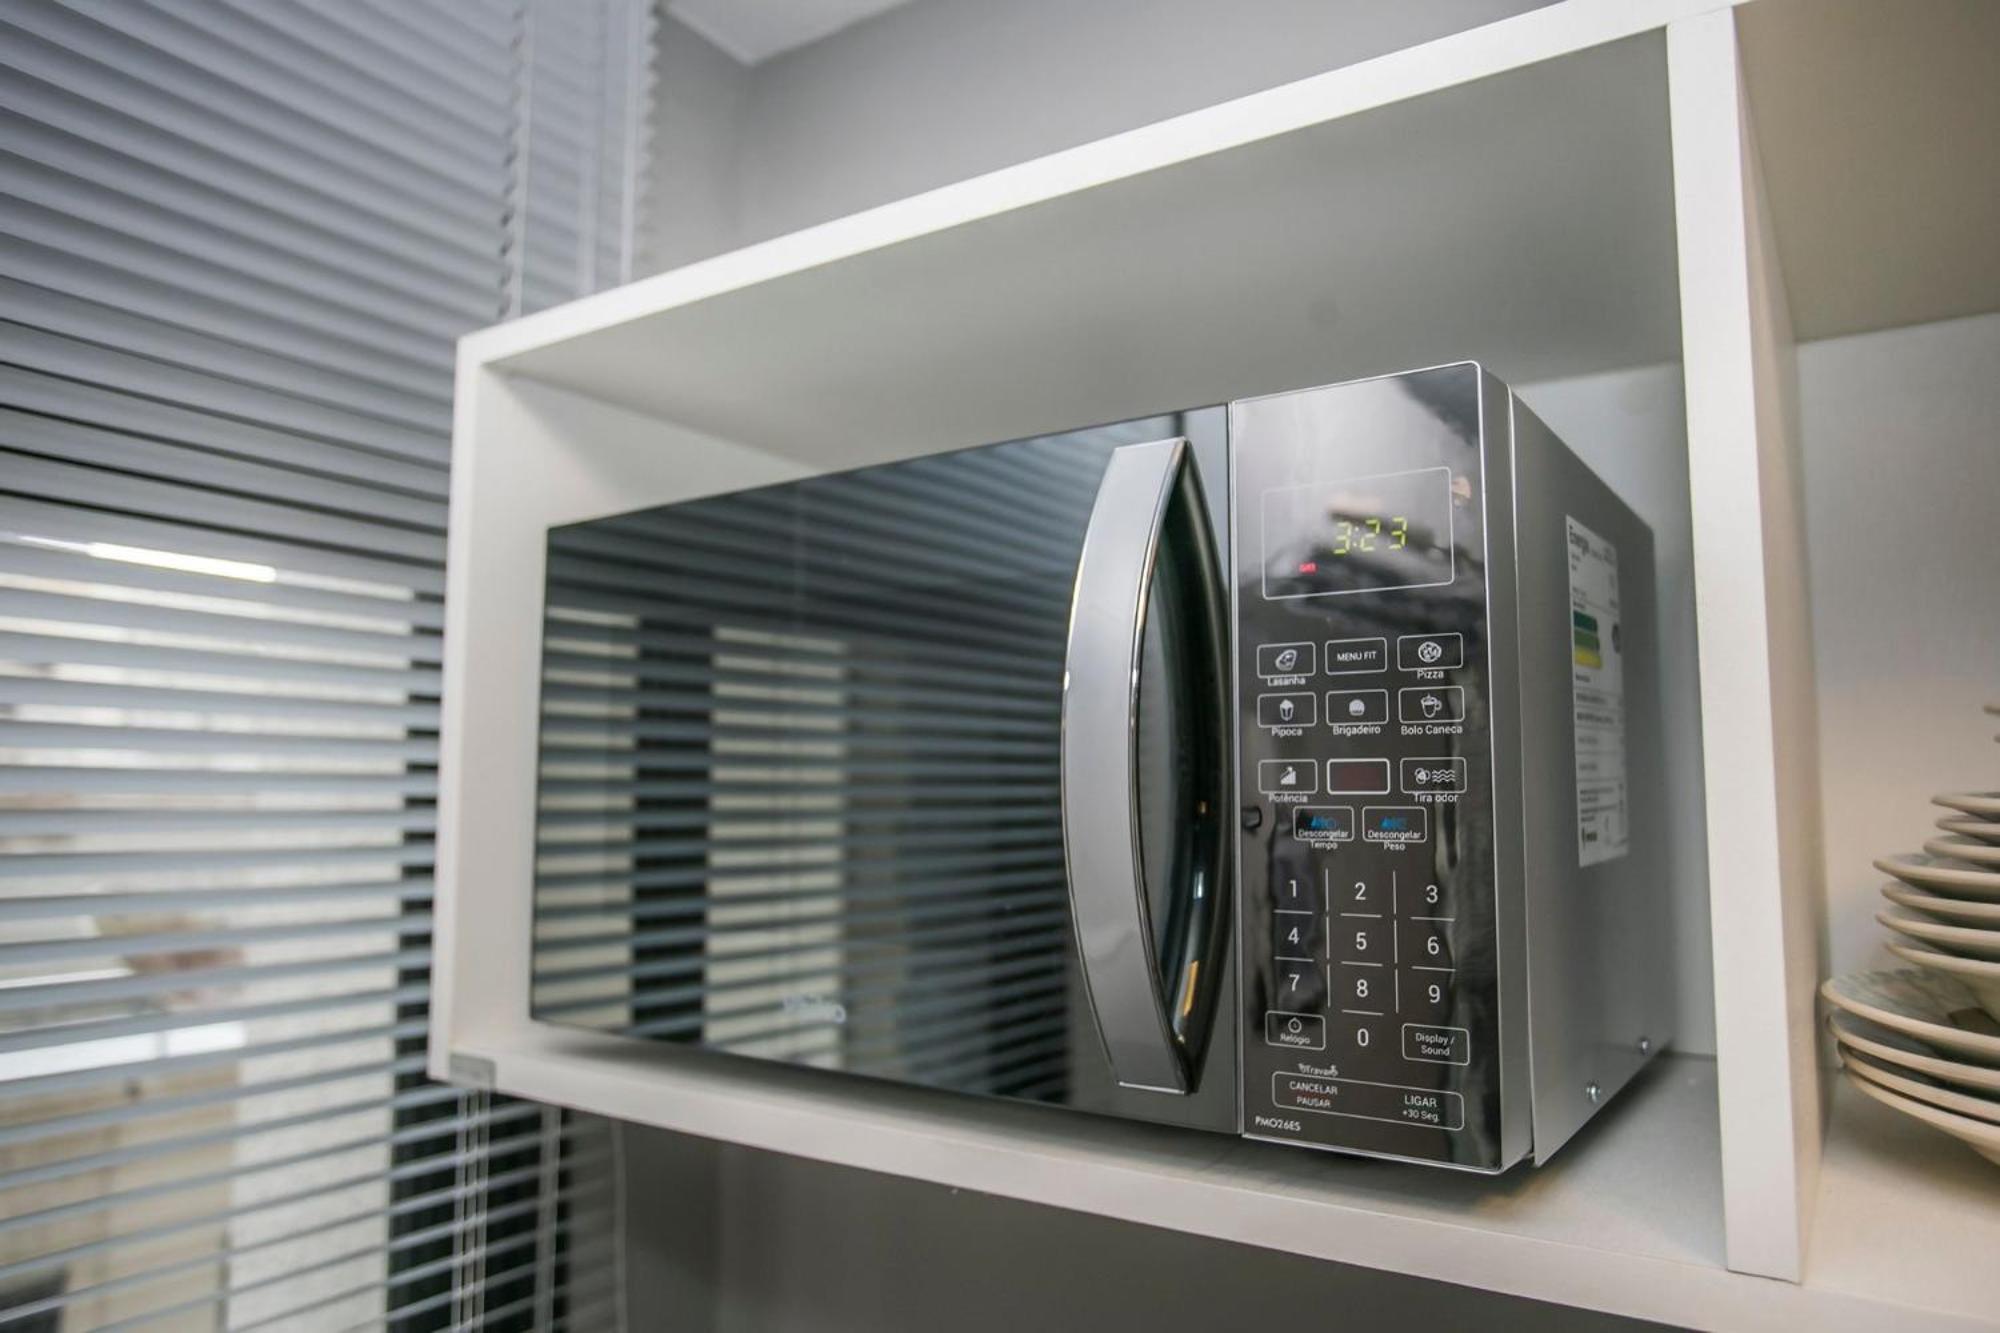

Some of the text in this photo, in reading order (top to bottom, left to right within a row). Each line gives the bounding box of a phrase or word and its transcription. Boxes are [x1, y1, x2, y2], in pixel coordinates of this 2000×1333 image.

[1333, 516, 1408, 555] 3:23
[1336, 651, 1377, 663] MENU FIT
[1417, 669, 1445, 680] Pizza
[1267, 676, 1306, 687] Lasanha
[1271, 726, 1303, 738] Pipoca
[1333, 724, 1381, 737] Brigadeiro
[1401, 723, 1463, 736] Bolo Caneca
[1414, 793, 1459, 803] Tira odor
[1298, 829, 1349, 841] Descongelar
[1367, 829, 1421, 841] Descongelar
[1311, 840, 1338, 850] Tempo
[1383, 841, 1406, 851] Peso
[1289, 880, 1297, 898] 1
[1354, 882, 1366, 900] 2
[1425, 885, 1438, 903] 3
[1288, 927, 1300, 944] 4
[1355, 932, 1367, 950] 5
[1427, 936, 1440, 954] 6
[1288, 974, 1300, 991] 7
[1356, 979, 1369, 997] 8
[1428, 985, 1441, 1003] 9
[1356, 1028, 1370, 1047] 0
[1415, 1032, 1449, 1045] Display
[1420, 1045, 1450, 1057] Sound
[1289, 1080, 1338, 1095] CANCELAR
[1296, 1096, 1331, 1108] PAUSAR
[1404, 1095, 1437, 1107] LIGAR
[1402, 1108, 1421, 1118] +30
